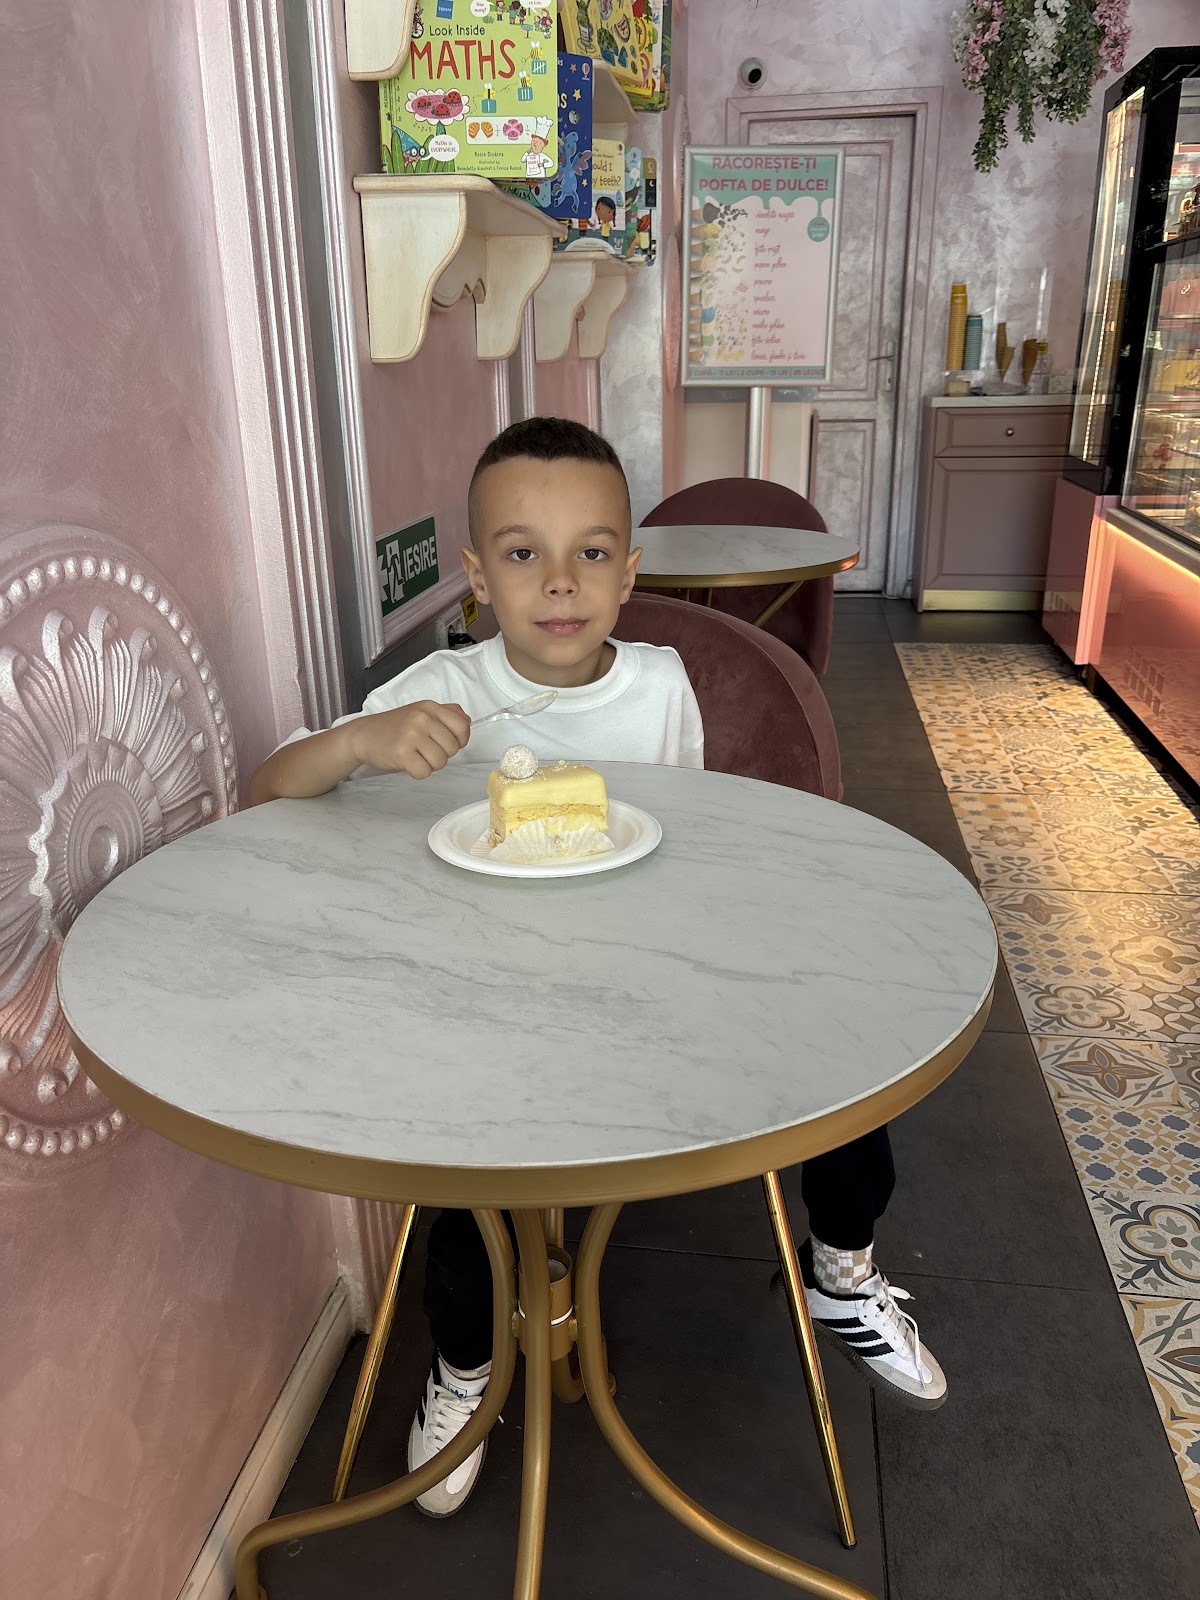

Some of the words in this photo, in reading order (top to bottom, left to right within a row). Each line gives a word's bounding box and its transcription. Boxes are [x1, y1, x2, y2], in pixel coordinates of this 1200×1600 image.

[429, 25, 453, 36] Look
[456, 24, 486, 36] Inside
[410, 39, 516, 80] MATHS
[599, 175, 622, 187] teeth?
[699, 178, 747, 191] POFTA
[751, 178, 772, 191] DE
[776, 178, 829, 191] DULCE!
